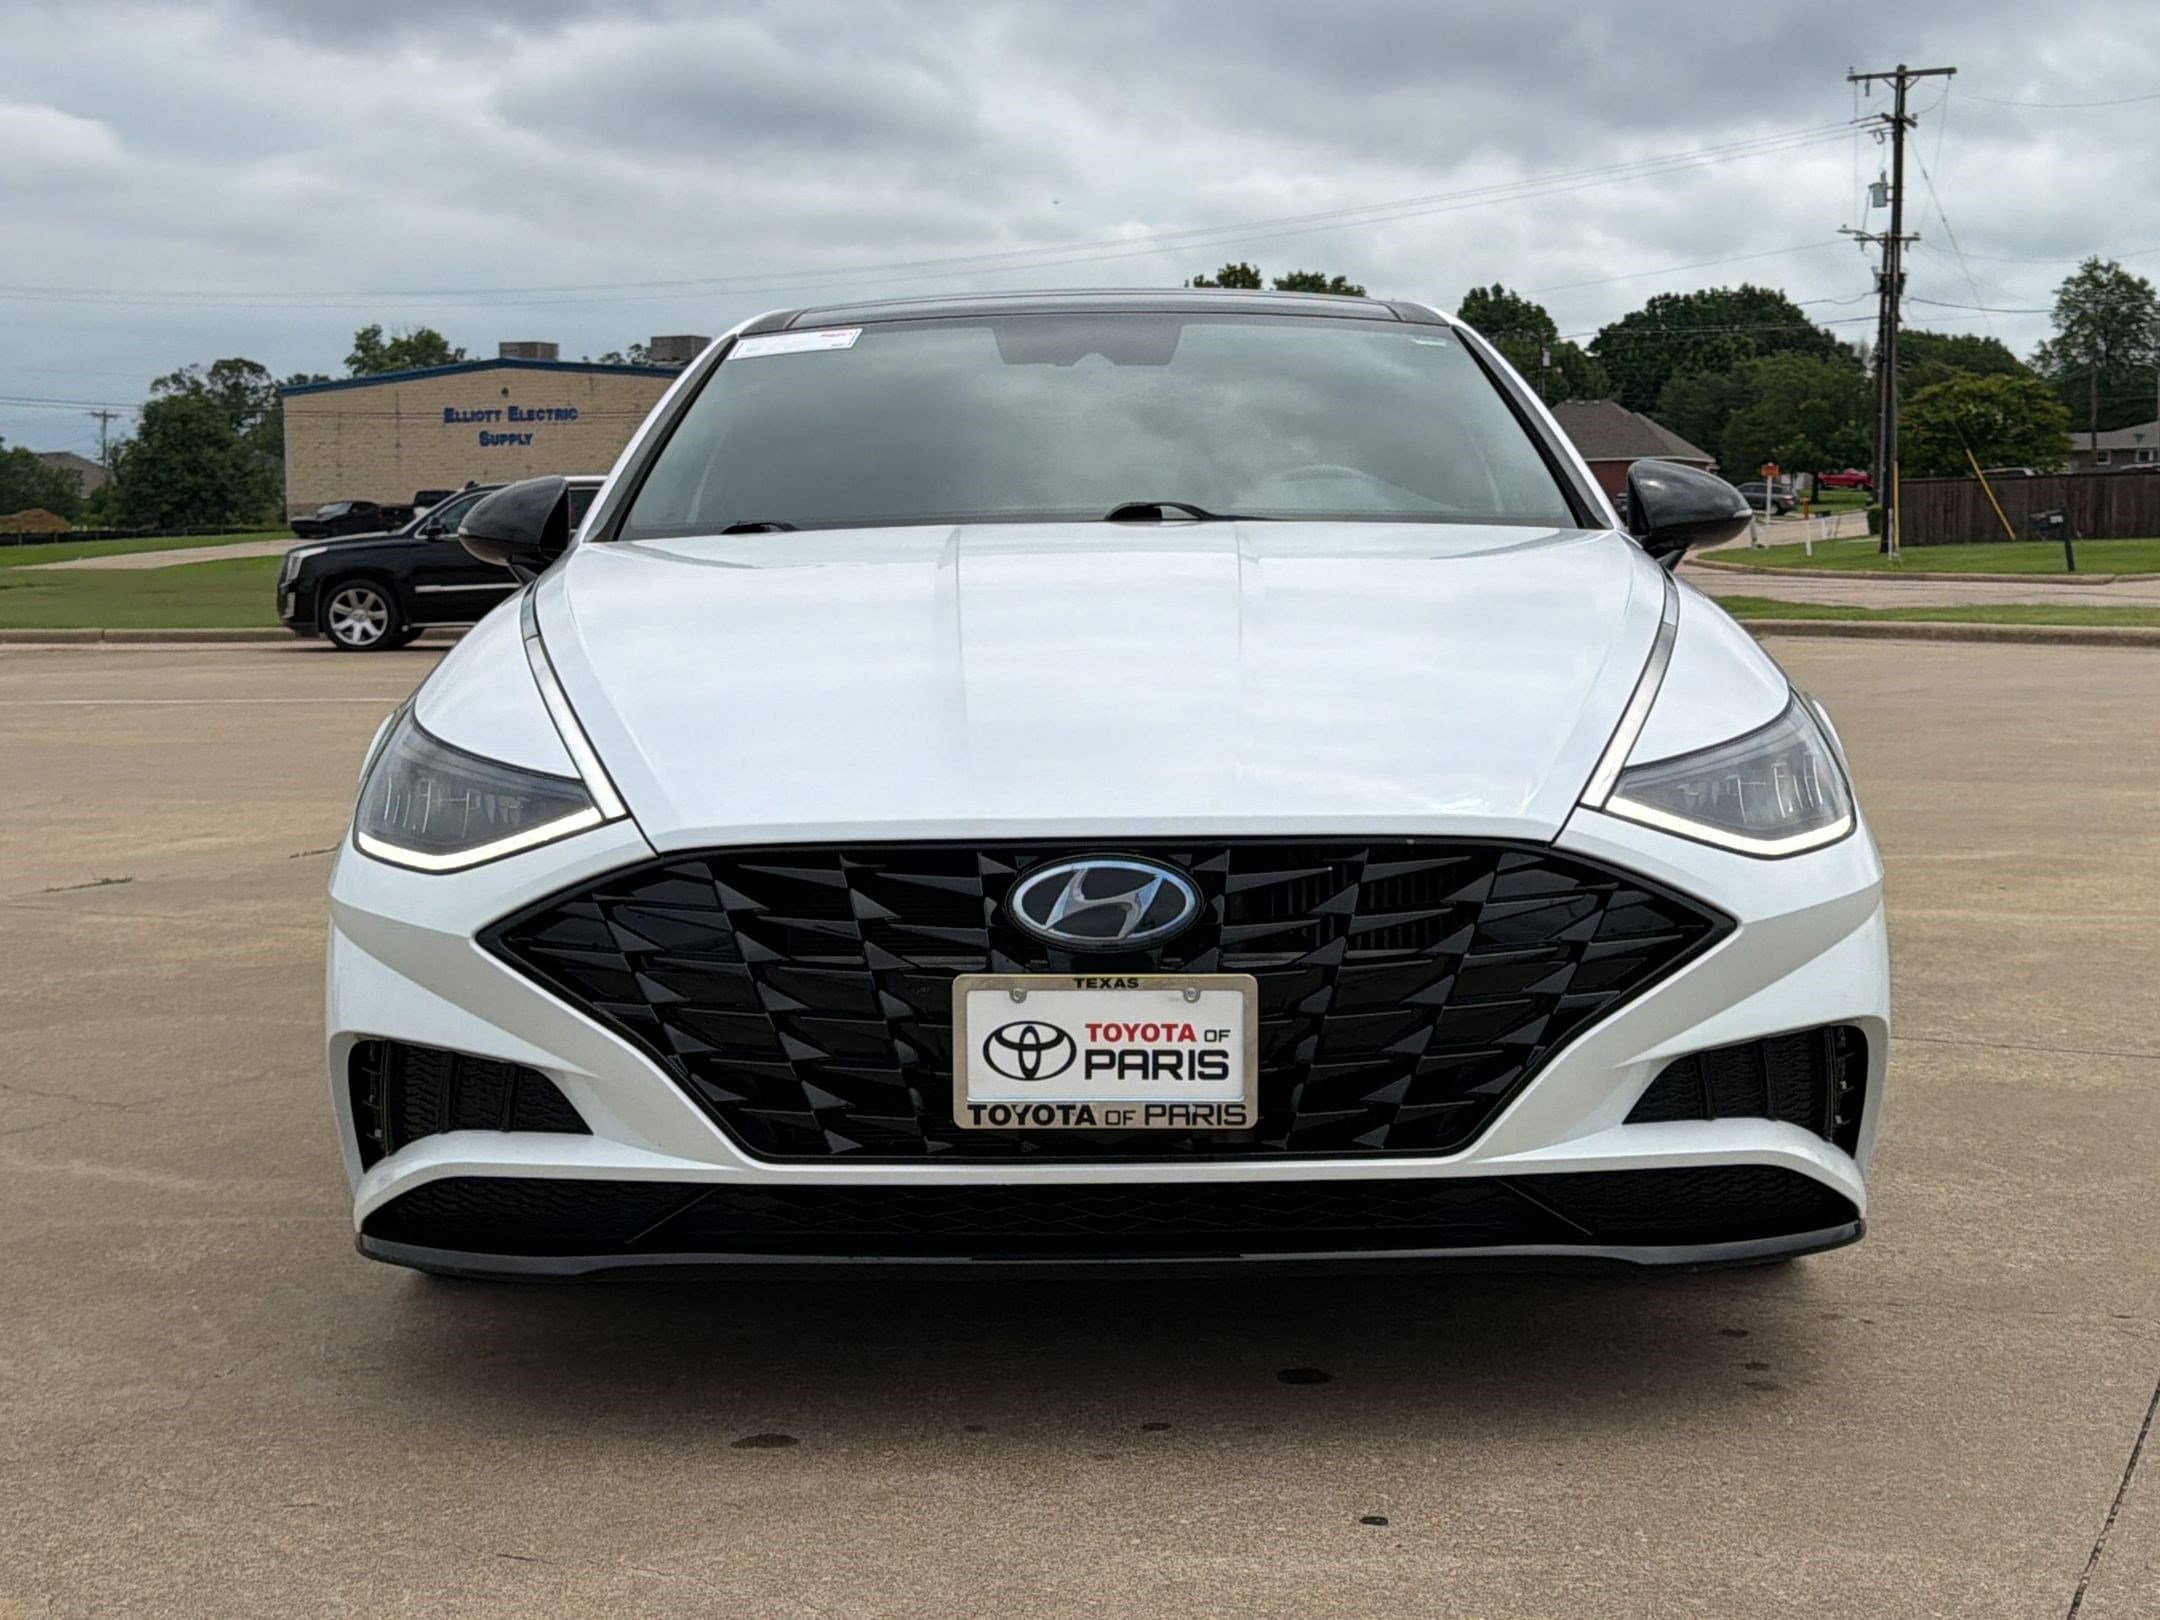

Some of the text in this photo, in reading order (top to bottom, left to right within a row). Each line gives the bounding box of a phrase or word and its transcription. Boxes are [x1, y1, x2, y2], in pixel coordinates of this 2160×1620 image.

[443, 406, 578, 423] ELLIOTT ELECTRIC
[479, 430, 532, 446] SUPPLY
[1074, 977, 1139, 988] TEXAS
[1084, 1023, 1231, 1042] TOYOTA OF
[1084, 1049, 1229, 1080] PARIS
[968, 1104, 1247, 1126] TOYOTA OF PARIS
